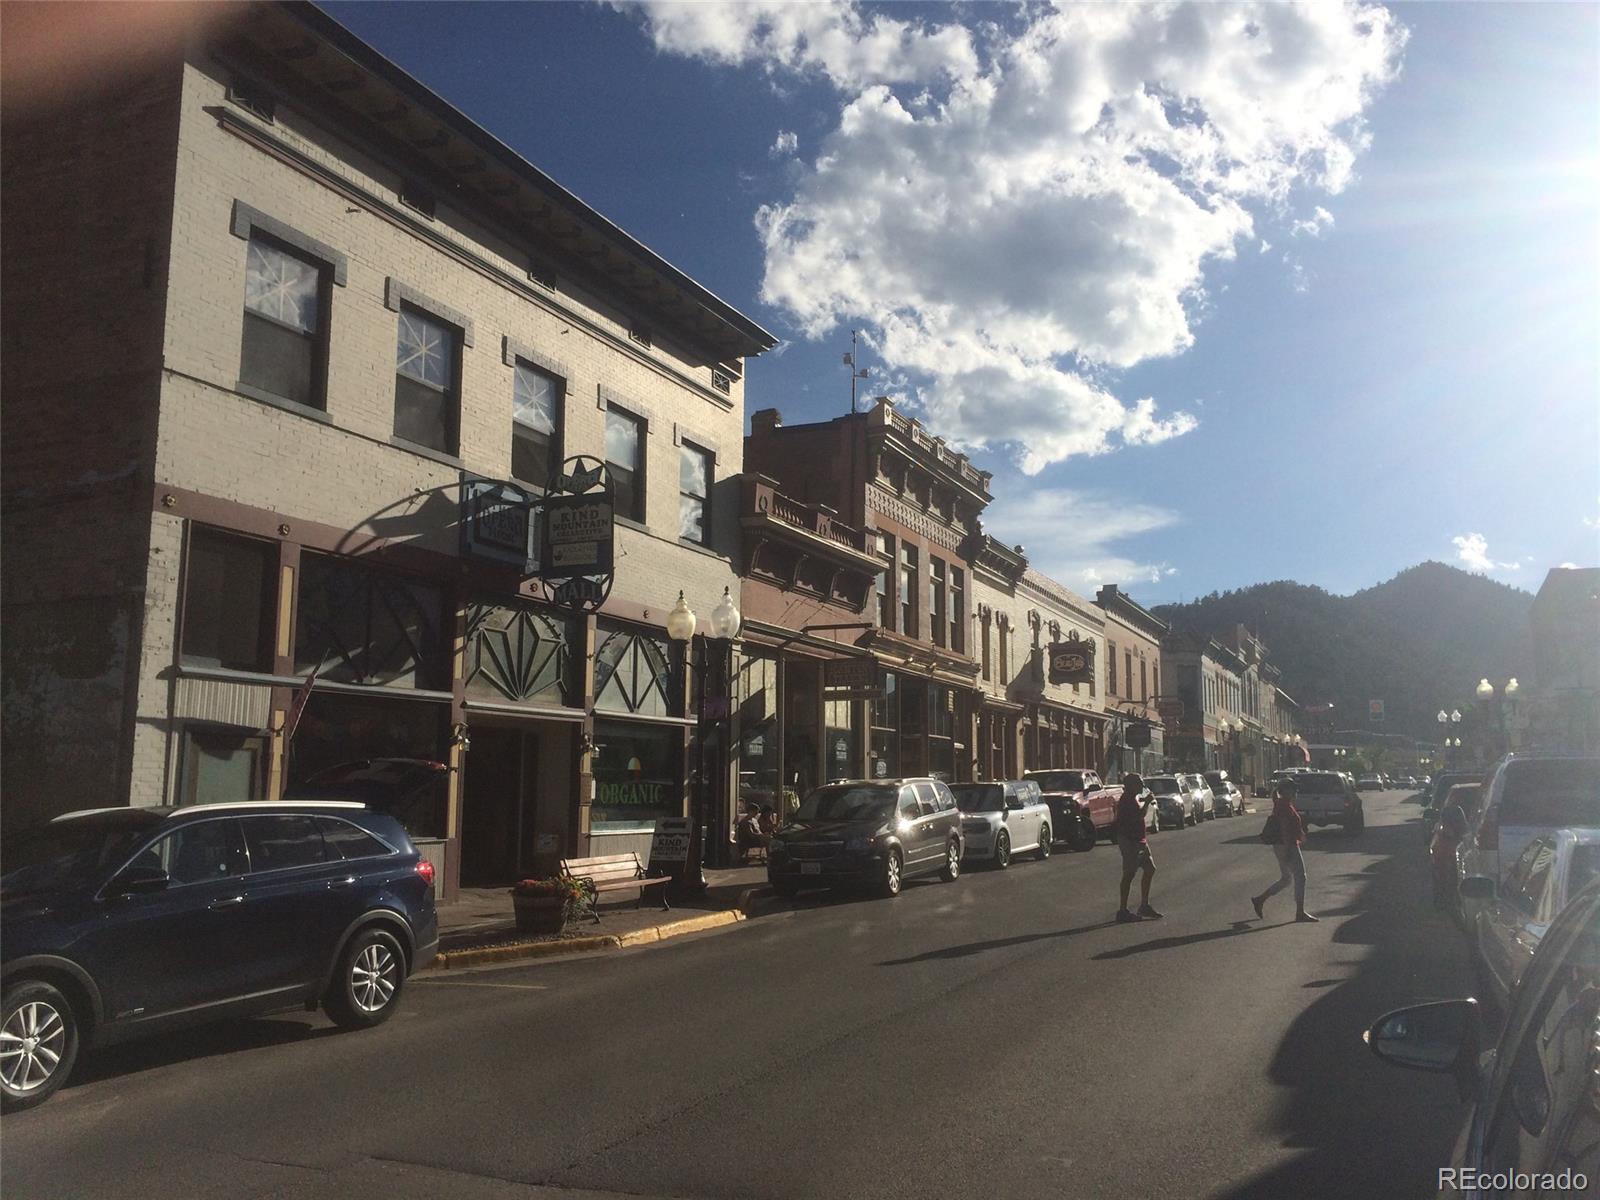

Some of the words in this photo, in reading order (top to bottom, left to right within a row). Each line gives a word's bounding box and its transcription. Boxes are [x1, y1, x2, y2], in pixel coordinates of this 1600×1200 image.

[561, 509, 599, 522] KIND
[552, 519, 609, 530] MOUNTAIN
[600, 783, 663, 804] ORGANIC
[658, 838, 682, 846] KIND
